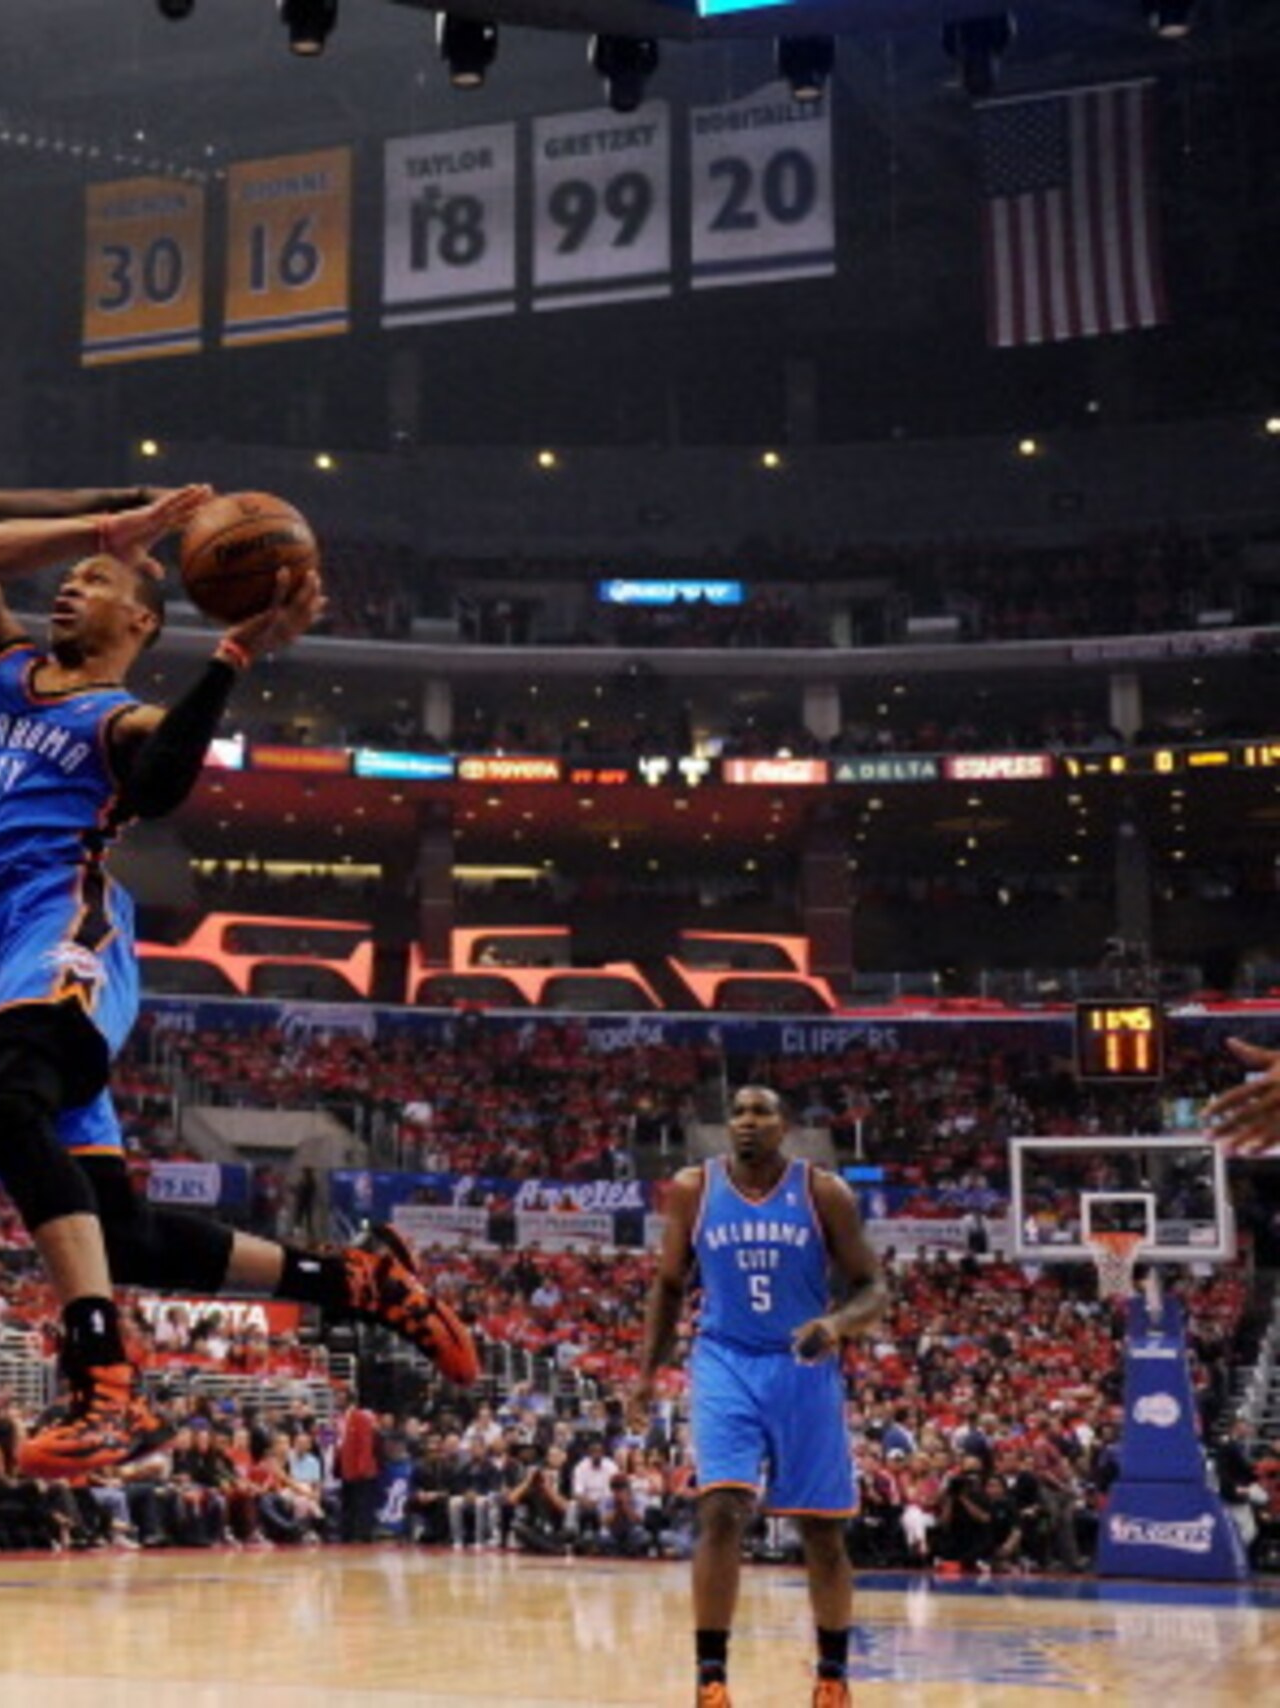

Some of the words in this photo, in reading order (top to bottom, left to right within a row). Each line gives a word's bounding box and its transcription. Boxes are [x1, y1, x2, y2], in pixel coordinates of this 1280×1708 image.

[544, 122, 657, 159] GRETZKY
[405, 148, 494, 177] TAYLOR
[707, 147, 818, 232] 20
[547, 171, 655, 254] 99
[409, 192, 486, 272] 18
[96, 235, 183, 311] 30
[249, 217, 320, 292] 16
[488, 759, 559, 780] TOYOTA
[860, 760, 936, 779] DELTA
[950, 756, 1044, 779] STAPLES
[1107, 1034, 1147, 1071] 11
[749, 1274, 772, 1313] 5
